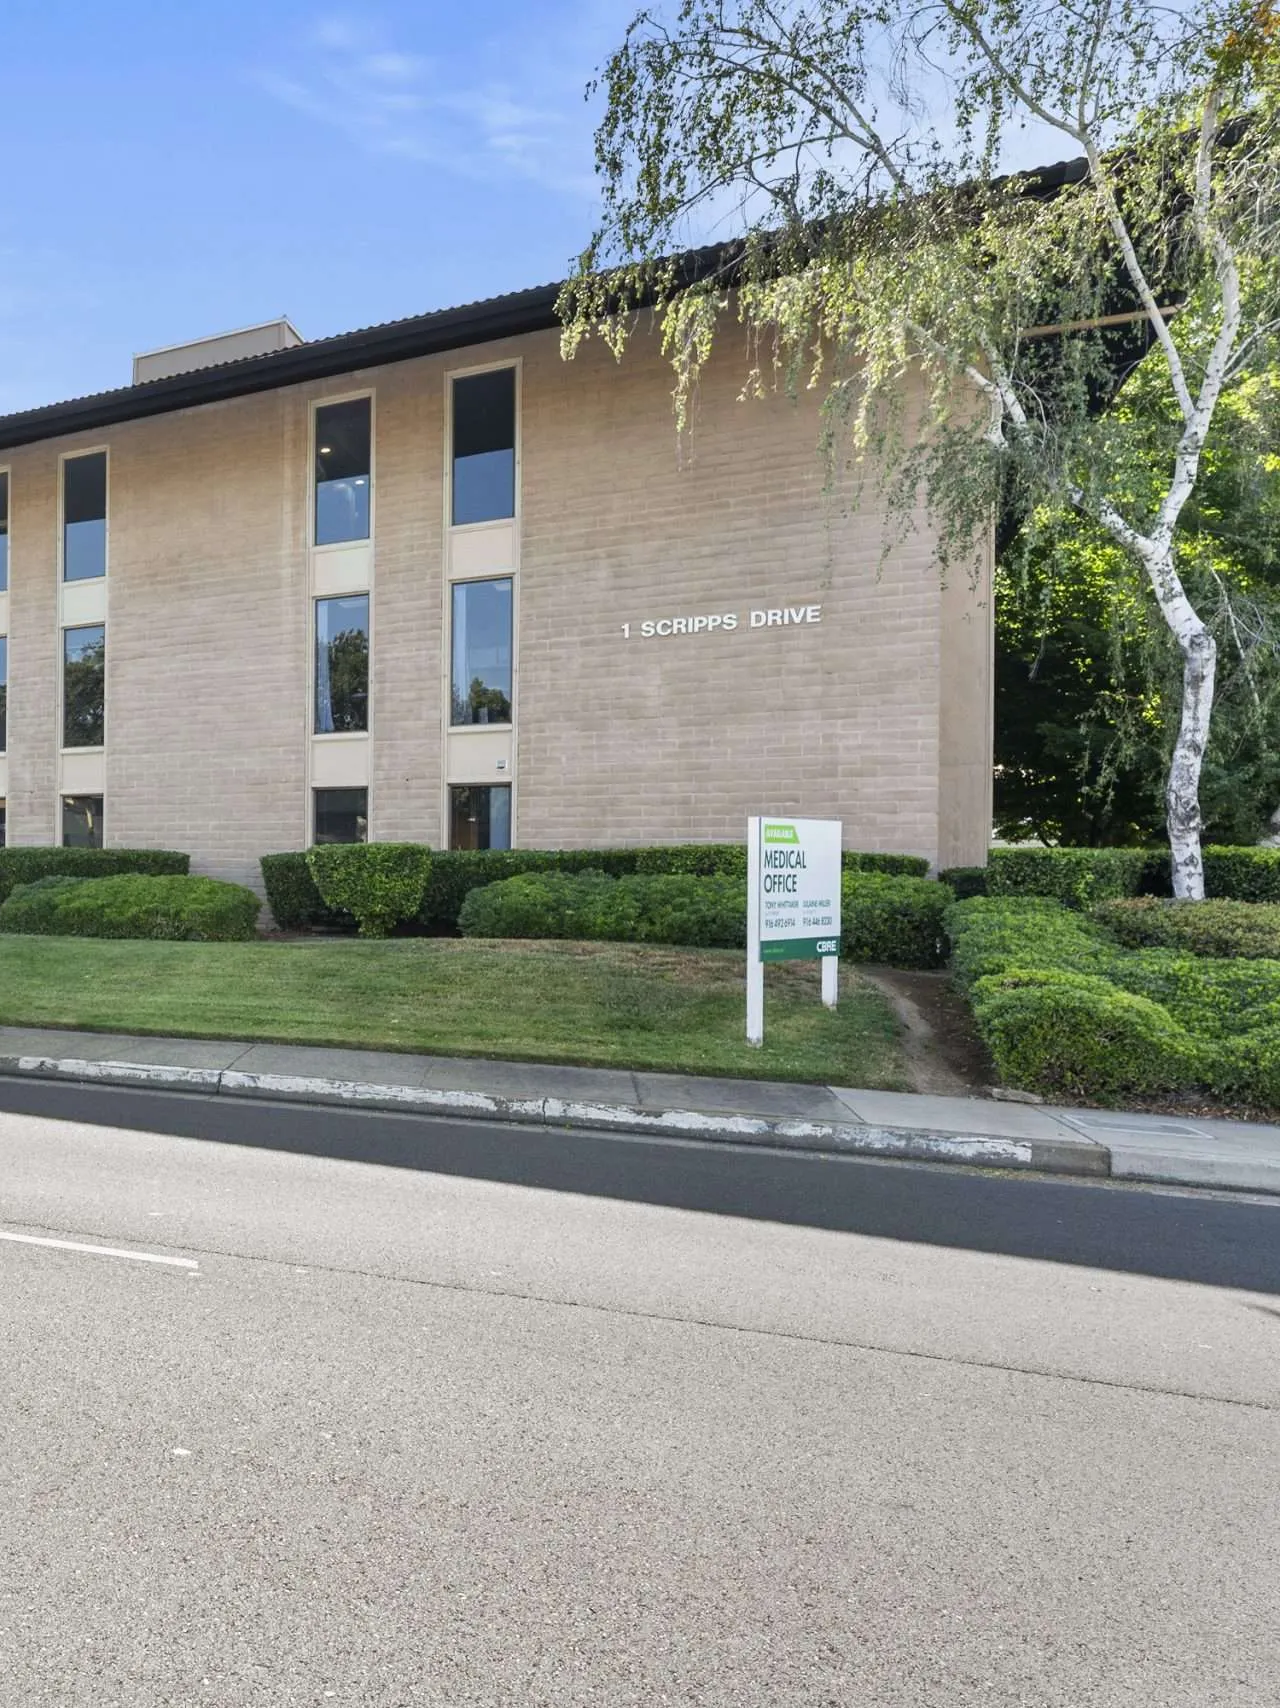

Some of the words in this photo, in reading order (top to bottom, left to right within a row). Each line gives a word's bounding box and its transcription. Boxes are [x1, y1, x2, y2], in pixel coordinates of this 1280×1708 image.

[621, 623, 630, 639] 1
[640, 613, 738, 638] SCRIPPS
[750, 605, 822, 628] DRIVE
[764, 850, 807, 869] MEDICAL
[764, 873, 797, 893] OFFICE
[816, 940, 837, 953] CBRE
